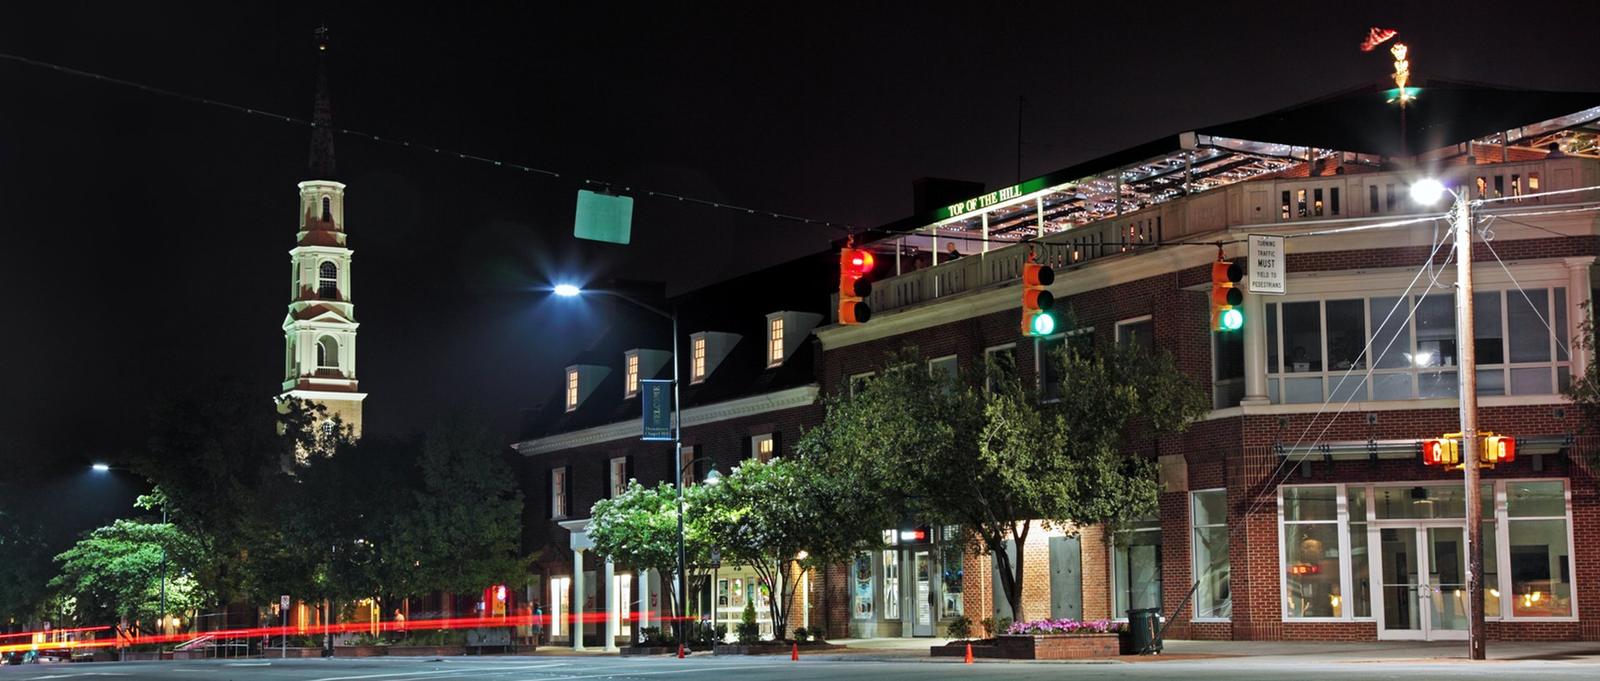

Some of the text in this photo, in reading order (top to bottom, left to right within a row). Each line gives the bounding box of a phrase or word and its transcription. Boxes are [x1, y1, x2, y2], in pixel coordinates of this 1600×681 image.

[948, 185, 1022, 217] TOP OF THE HILL
[1257, 259, 1275, 268] MUST
